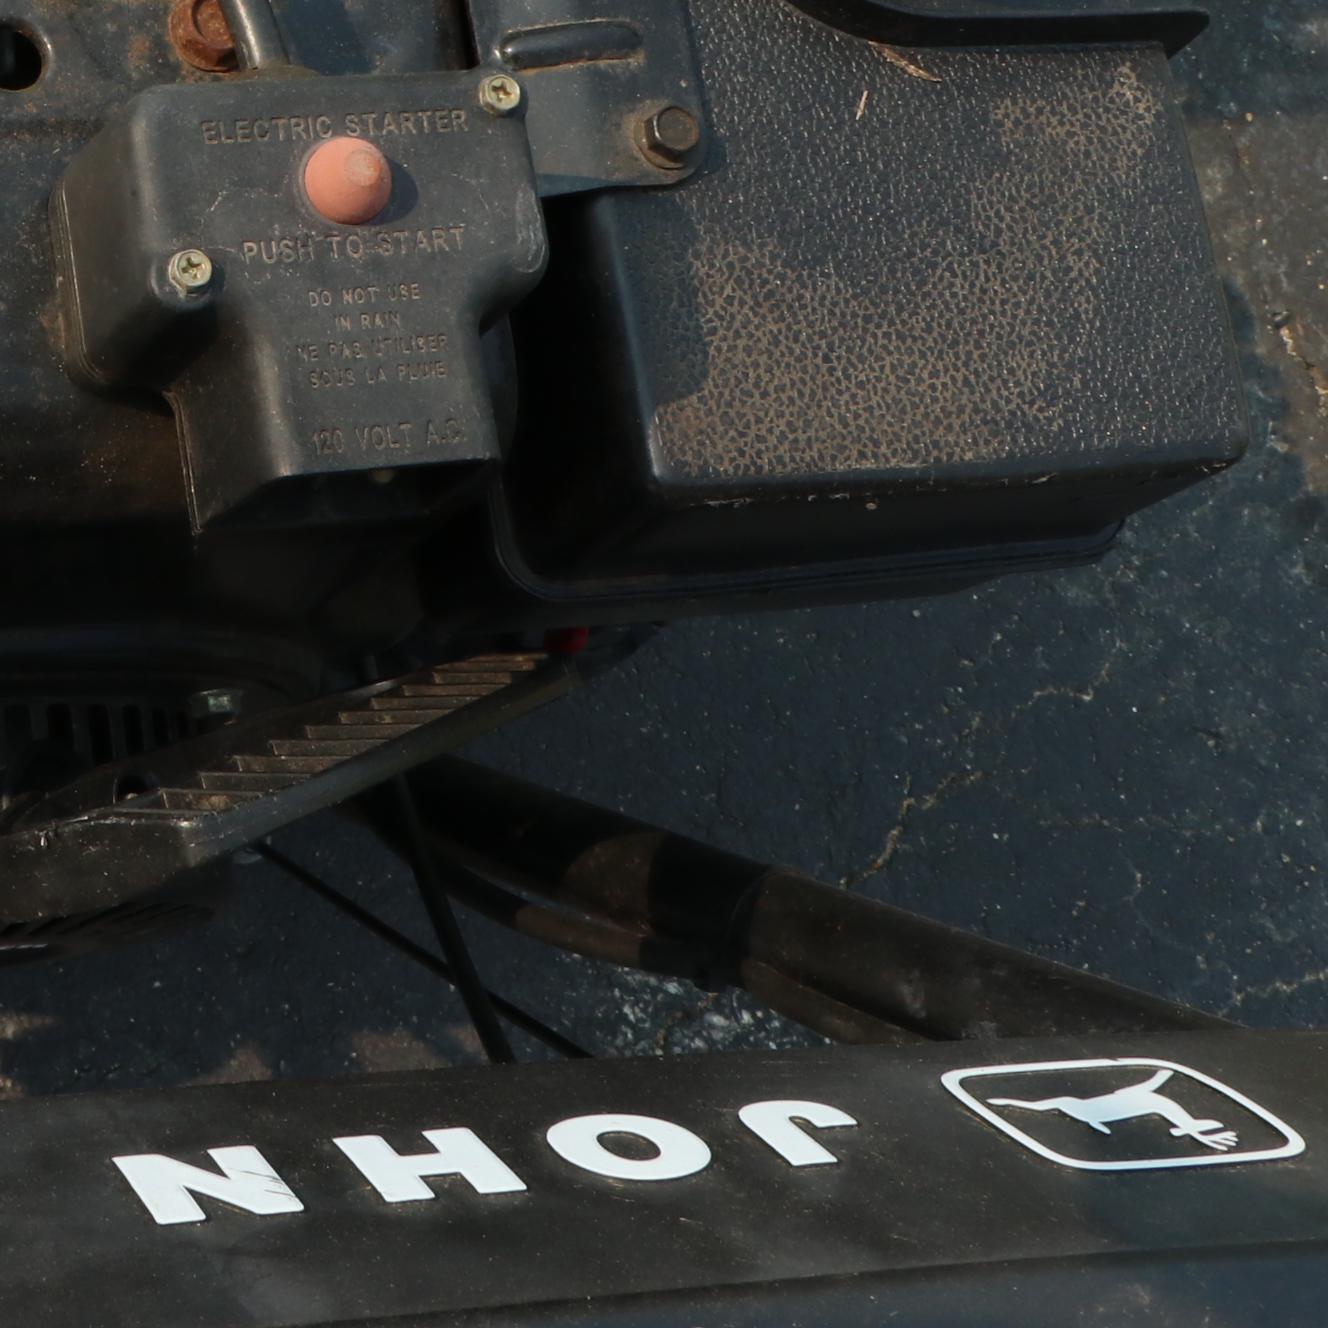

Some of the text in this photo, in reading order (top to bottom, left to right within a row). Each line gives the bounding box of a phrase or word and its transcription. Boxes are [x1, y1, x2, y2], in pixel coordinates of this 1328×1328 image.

[201, 108, 469, 145] ELECTRIC STARTER
[242, 226, 467, 265] PUSH TO START
[308, 282, 422, 308] DO NOT USE
[333, 310, 402, 332] IN RAIN
[309, 367, 356, 389] SOUS
[364, 366, 388, 384] LA
[312, 426, 345, 455] 120
[354, 422, 413, 451] VOLT
[111, 1099, 859, 1226] JOHN
